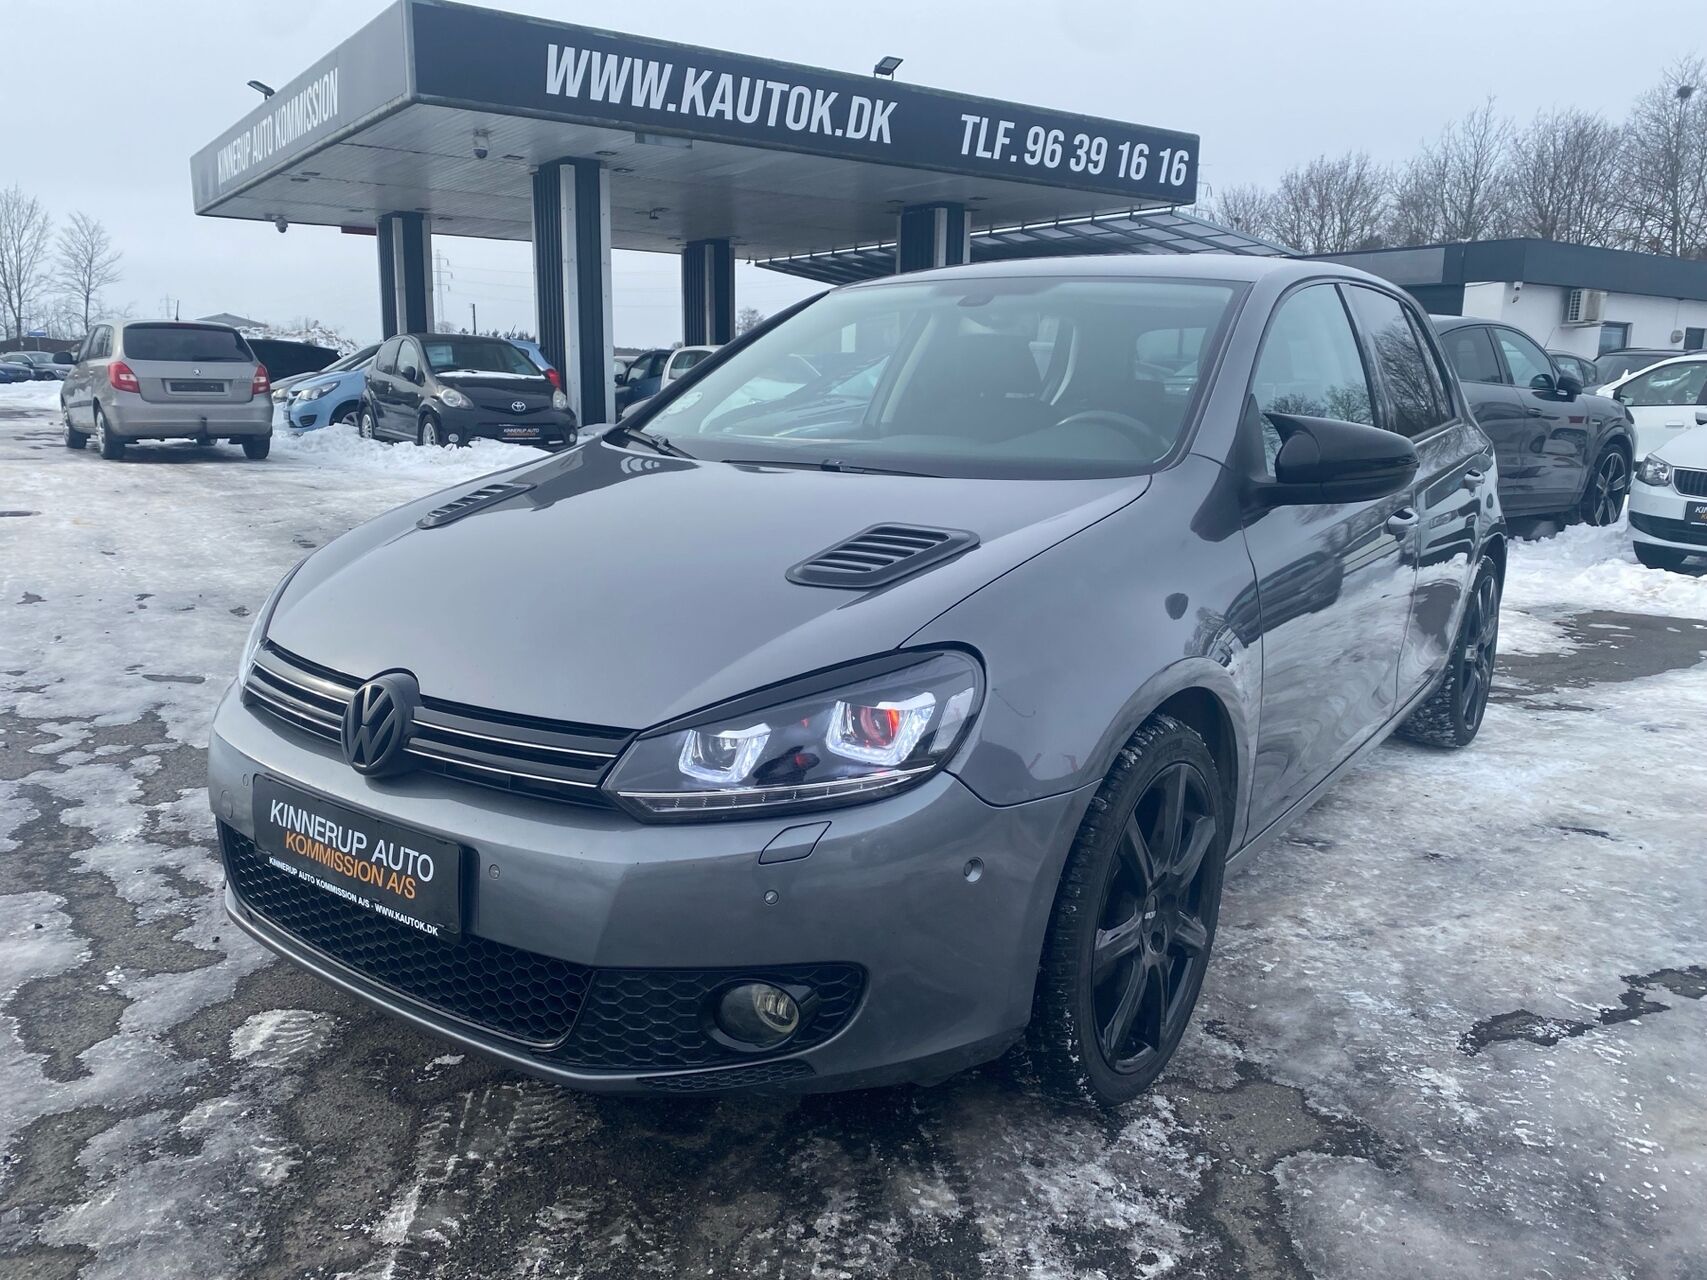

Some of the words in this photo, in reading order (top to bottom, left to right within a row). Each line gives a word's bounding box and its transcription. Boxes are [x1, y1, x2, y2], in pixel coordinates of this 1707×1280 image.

[217, 131, 251, 185] KINNERUP
[252, 114, 273, 165] AUTO
[275, 67, 338, 151] KOMMISSION
[546, 43, 898, 144] WWW.KAUTOK.DK
[960, 113, 1017, 163] TLF.
[1024, 125, 1065, 168] 96
[1069, 133, 1108, 175] 39
[1118, 141, 1150, 181] 16
[1159, 148, 1190, 186] 16
[270, 799, 368, 856] KINNERUP
[371, 839, 434, 882] AUTO
[285, 830, 384, 887] KOMMISSION
[386, 872, 416, 899] A/S
[268, 856, 298, 876] KINNERUP
[298, 870, 316, 884] AUTO
[315, 877, 357, 903] KOMMISSION
[358, 896, 370, 908] A/S
[374, 903, 439, 936] WWW.KAUTOK.DK
